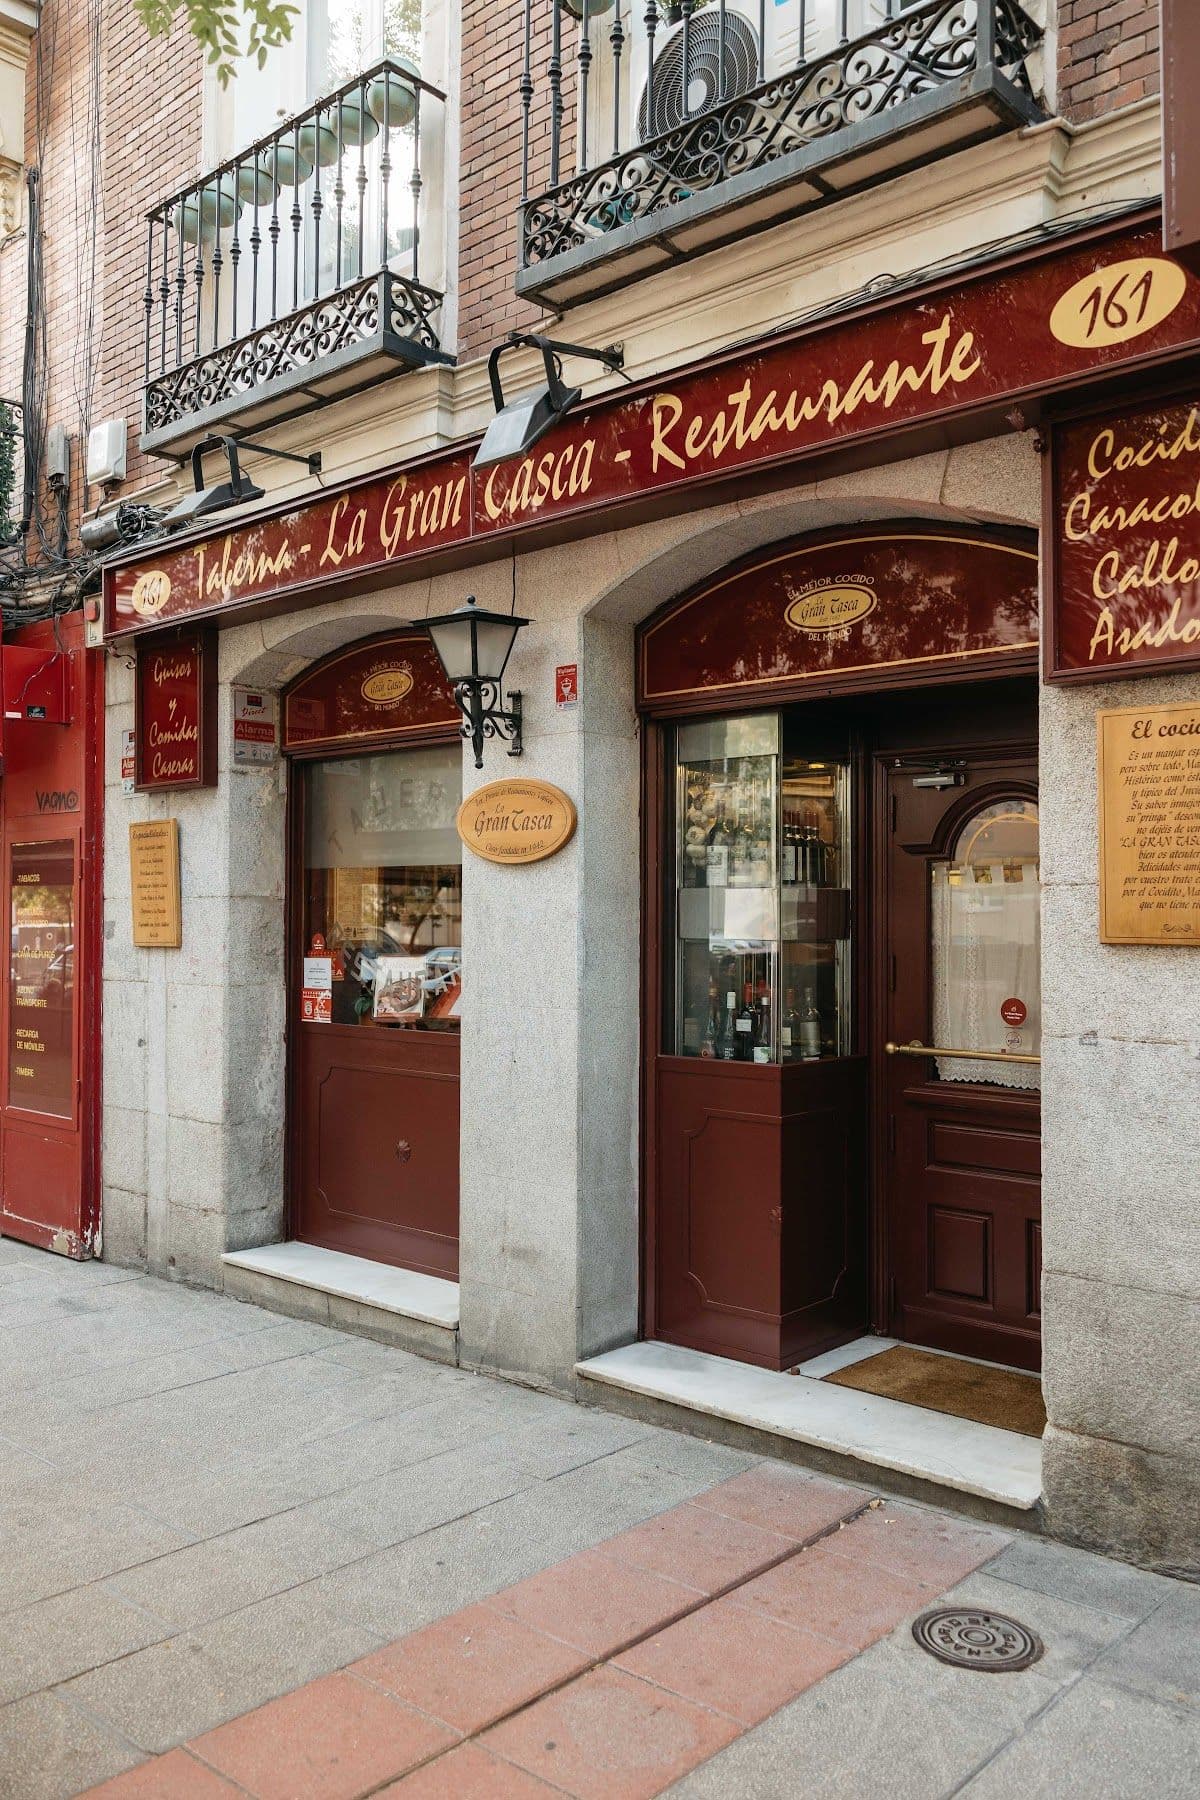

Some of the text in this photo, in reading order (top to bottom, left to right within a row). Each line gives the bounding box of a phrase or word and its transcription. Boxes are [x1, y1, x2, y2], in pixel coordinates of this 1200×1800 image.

[194, 536, 295, 600] Taberna
[320, 495, 366, 567] La
[380, 475, 466, 560] Gran
[651, 312, 982, 475] Restaurante
[1080, 270, 1154, 338] 161
[787, 574, 875, 600] EL MEJOR COCIDO
[831, 598, 859, 614] Tasca
[808, 632, 821, 641] DEL
[153, 657, 192, 687] Guisos
[168, 698, 177, 721] y
[150, 716, 199, 748] Comidas
[236, 722, 273, 736] Alarma
[1131, 719, 1152, 739] El
[152, 752, 194, 778] Caseras
[474, 809, 553, 838] Gran Tasca
[1140, 836, 1173, 848] GRAN
[16, 997, 48, 1008] TRANSPORTE
